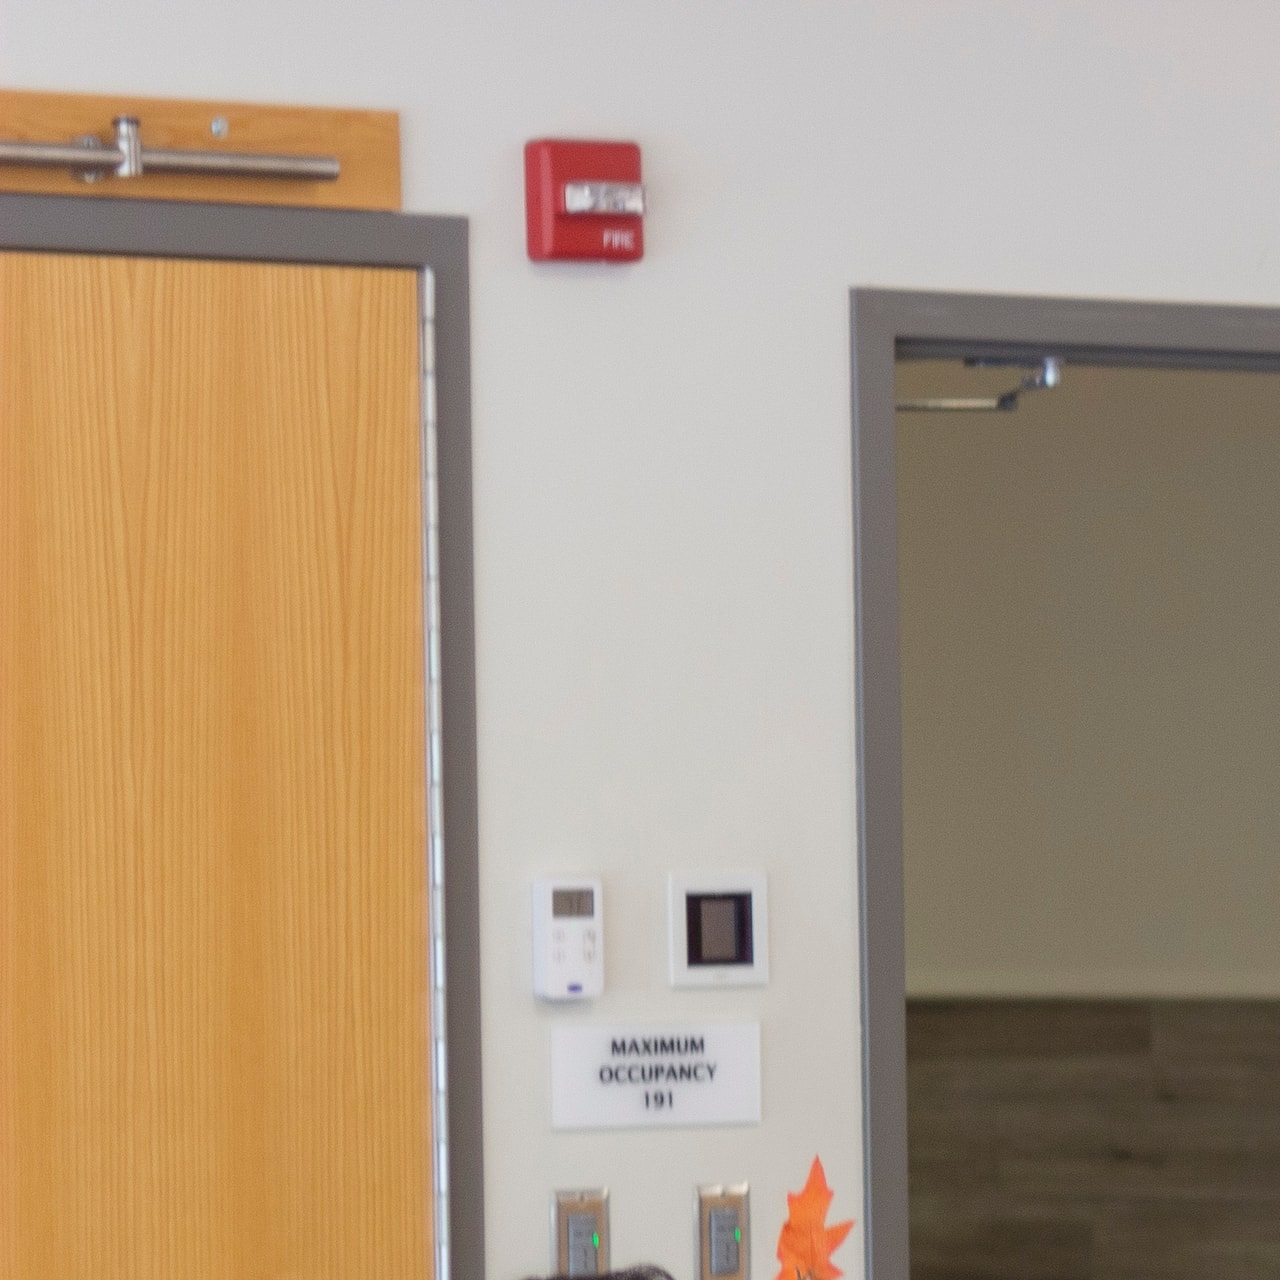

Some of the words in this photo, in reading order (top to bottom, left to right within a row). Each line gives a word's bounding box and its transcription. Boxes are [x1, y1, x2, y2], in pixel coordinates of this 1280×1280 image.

[611, 1036, 705, 1057] MAXIMUM
[599, 1062, 717, 1084] OCCUPANCY
[645, 1090, 674, 1110] 191
